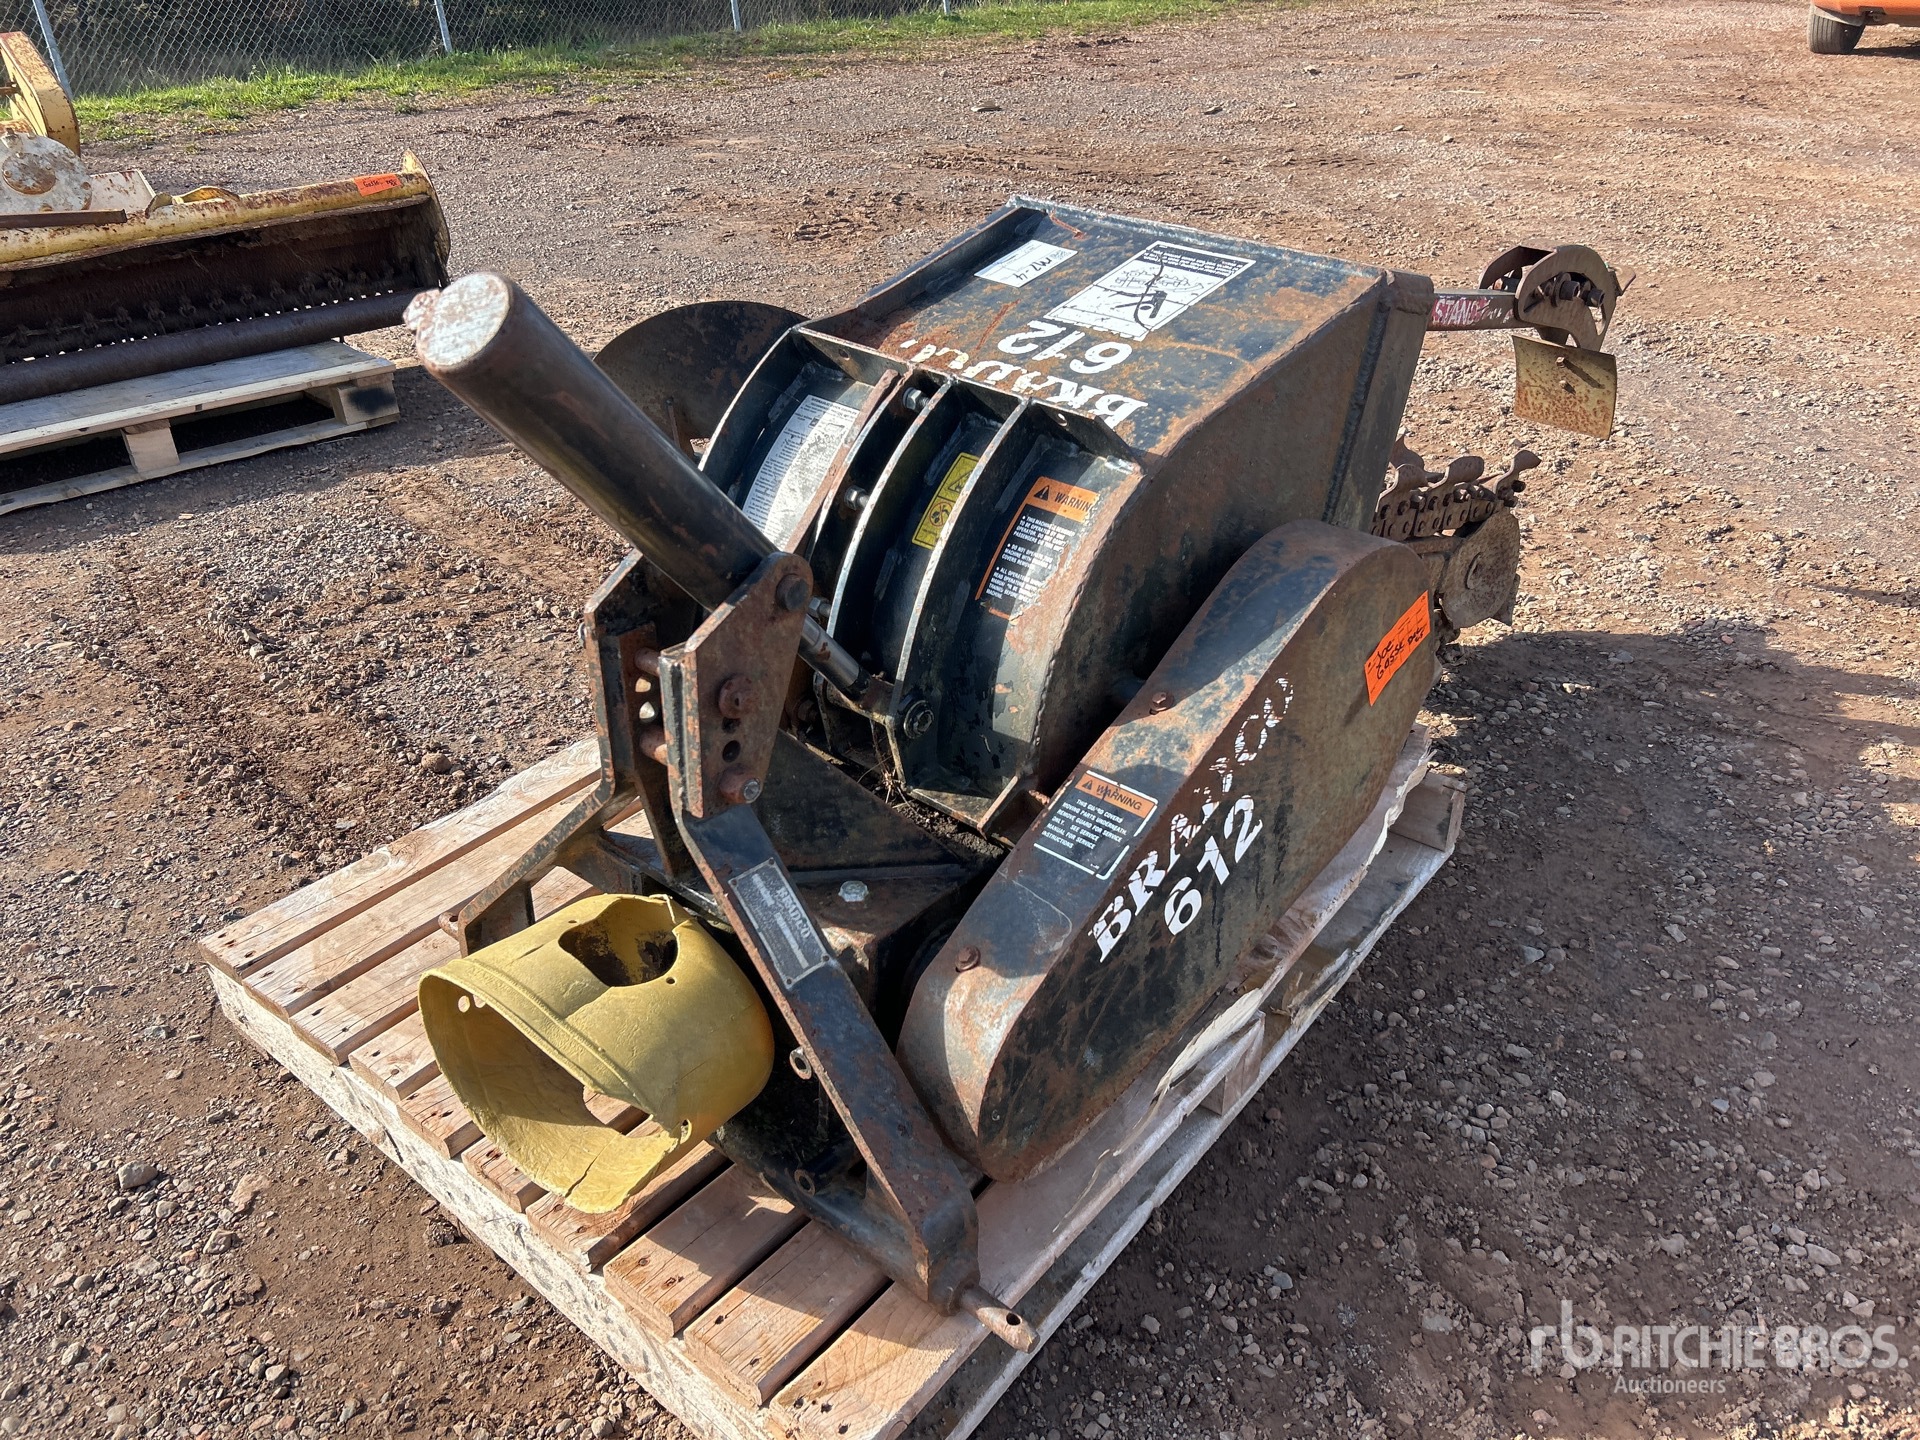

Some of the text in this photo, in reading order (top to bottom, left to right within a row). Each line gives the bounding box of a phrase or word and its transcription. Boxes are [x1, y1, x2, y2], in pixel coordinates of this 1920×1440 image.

[997, 320, 1134, 374] 612
[1054, 491, 1092, 513] WARNIN
[1096, 784, 1143, 809] WARNING
[1057, 809, 1075, 820] REMOVE
[1075, 818, 1092, 828] GUARD
[1103, 830, 1122, 841] SERVICE
[1080, 810, 1095, 820] PARTS
[1104, 811, 1123, 822] COVERS
[1047, 823, 1065, 834] MANUAL
[1076, 837, 1095, 848] SERVICE
[1080, 829, 1098, 840] SERVICE
[1164, 794, 1263, 936] 612
